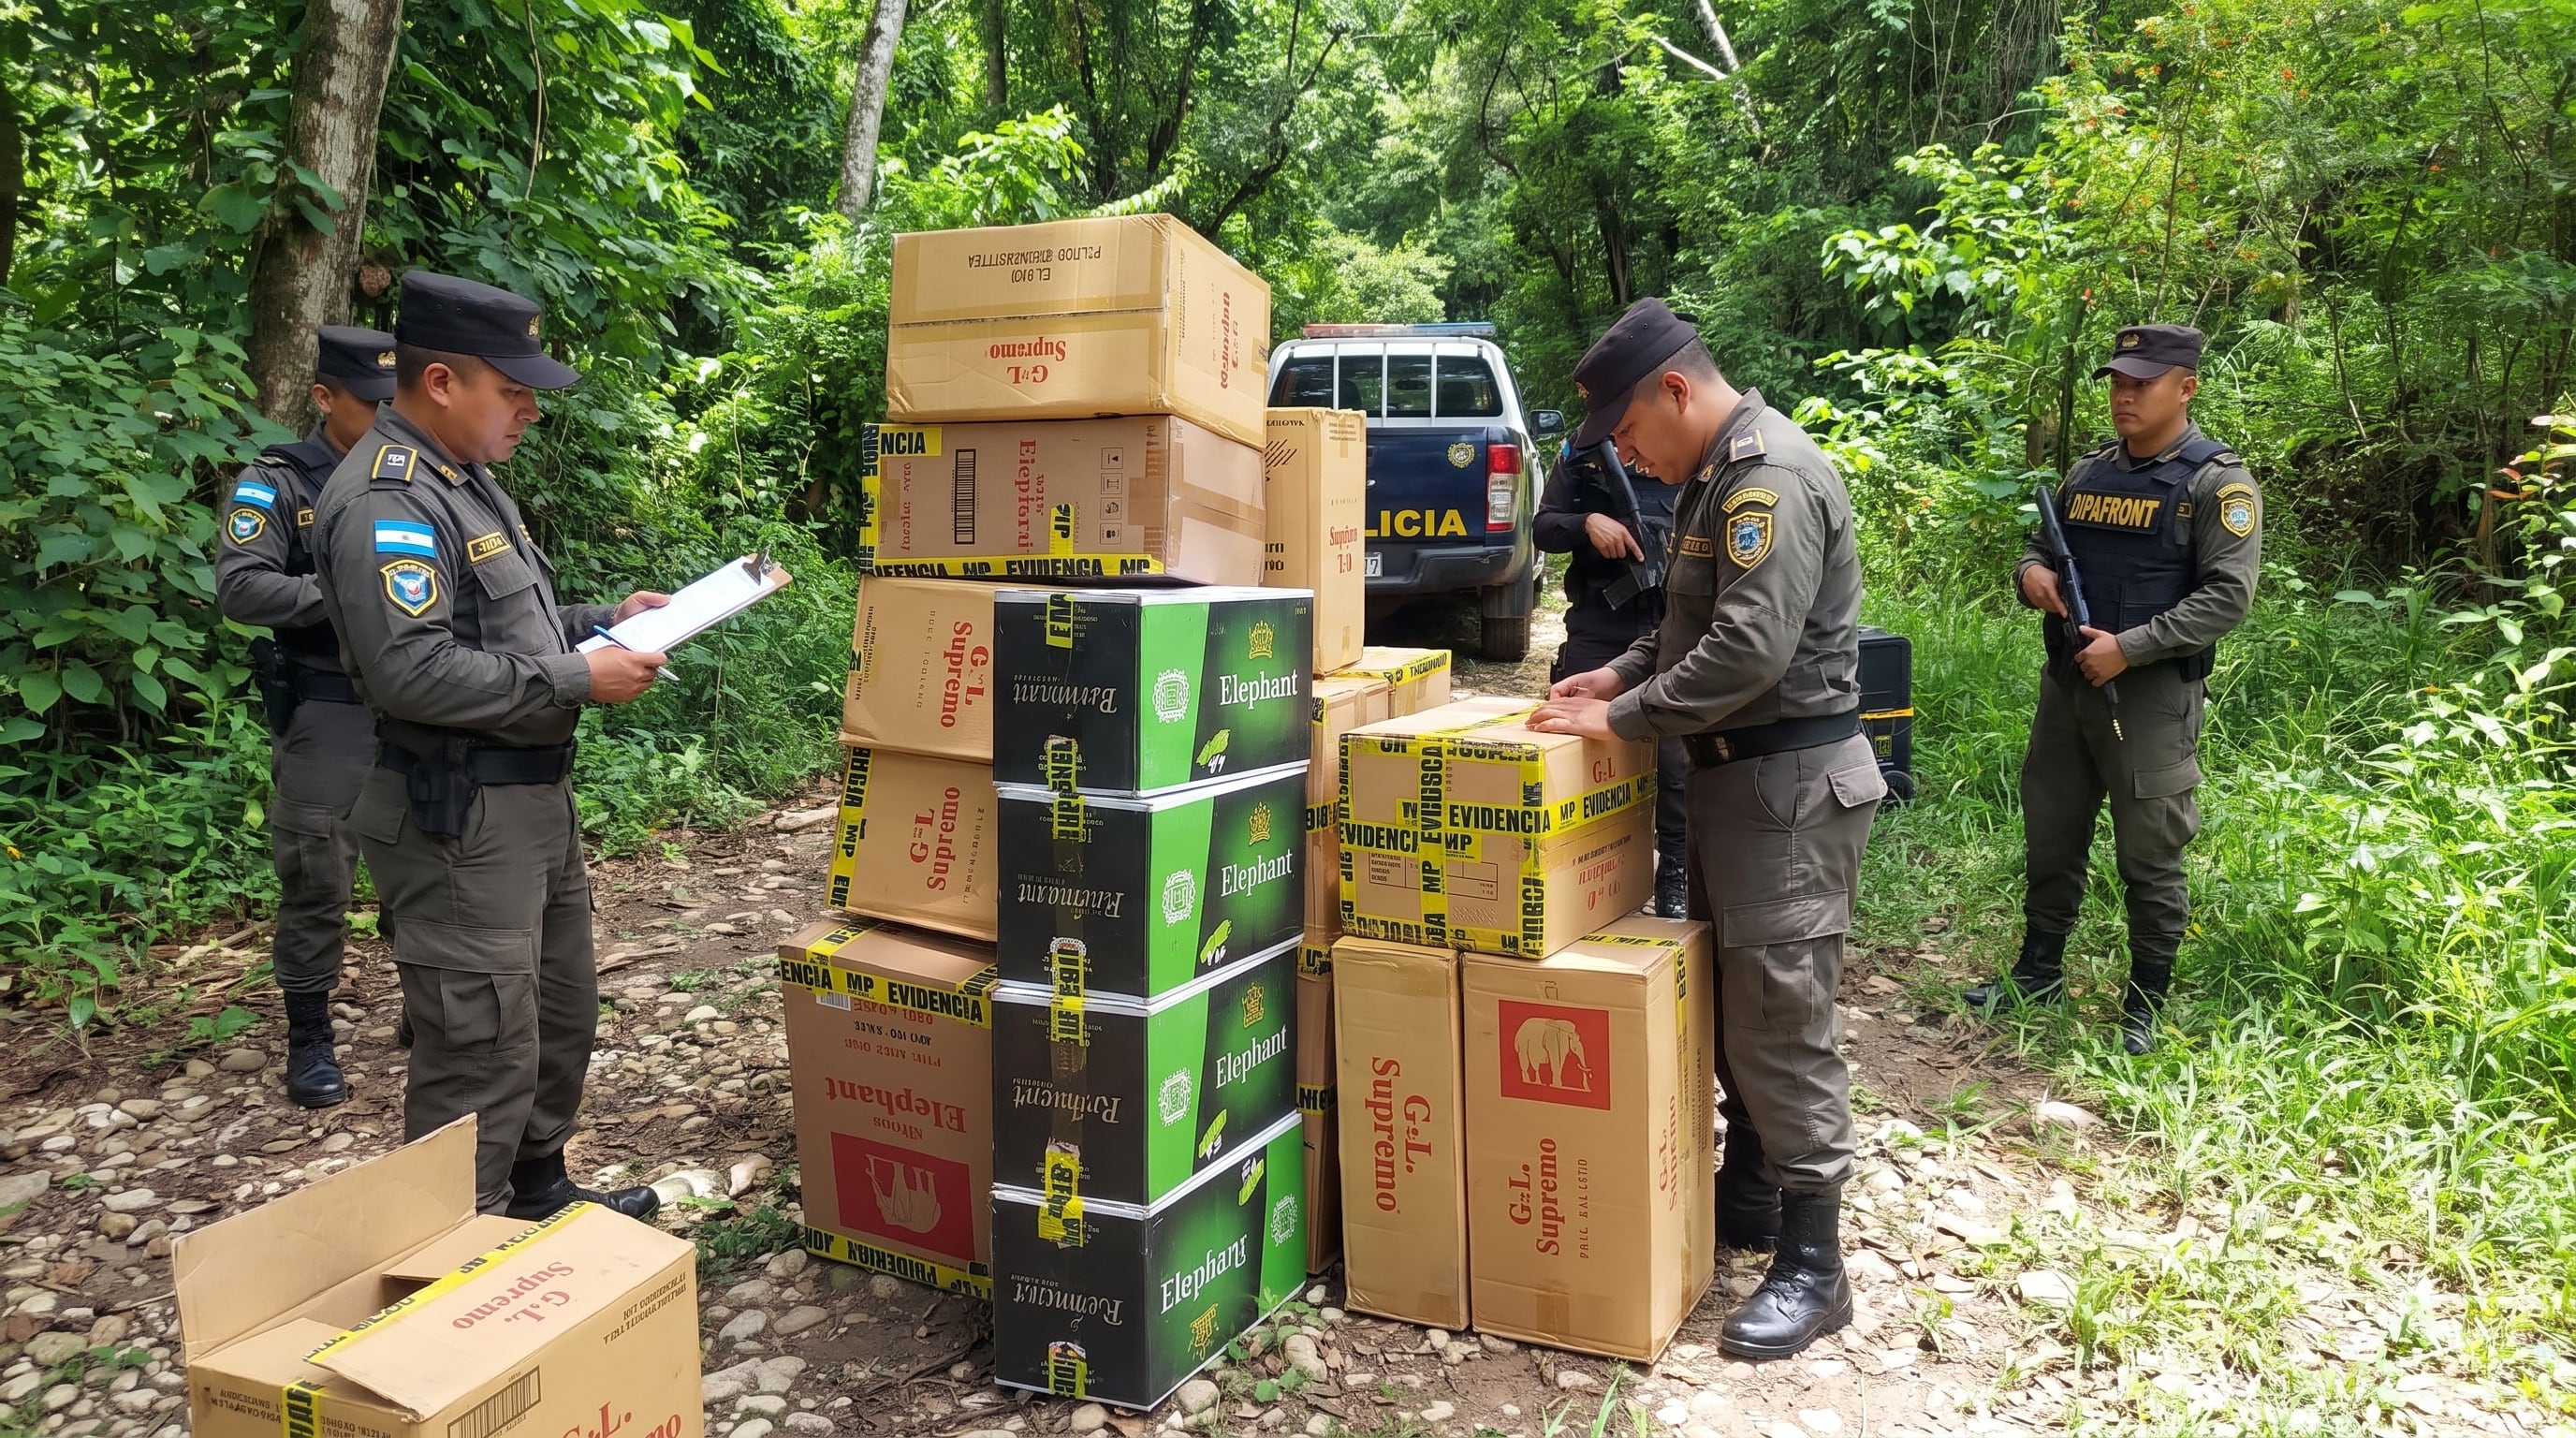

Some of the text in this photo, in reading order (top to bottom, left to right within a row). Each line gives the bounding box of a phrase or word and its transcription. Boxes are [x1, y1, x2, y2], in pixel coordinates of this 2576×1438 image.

[2068, 493, 2161, 528] DIPAFRONT
[940, 621, 973, 728] Supremo
[1219, 668, 1298, 710] Elephant
[927, 786, 960, 891] Supremo
[1448, 805, 1552, 834] EVIDENCIA
[1559, 800, 1576, 821] MP
[1220, 847, 1294, 900] Elephant
[1421, 860, 1442, 894] MP
[845, 973, 875, 994] MP
[1215, 1024, 1288, 1091] Elephant
[1365, 1056, 1402, 1213] Supremo
[1536, 1137, 1565, 1256] Supremo
